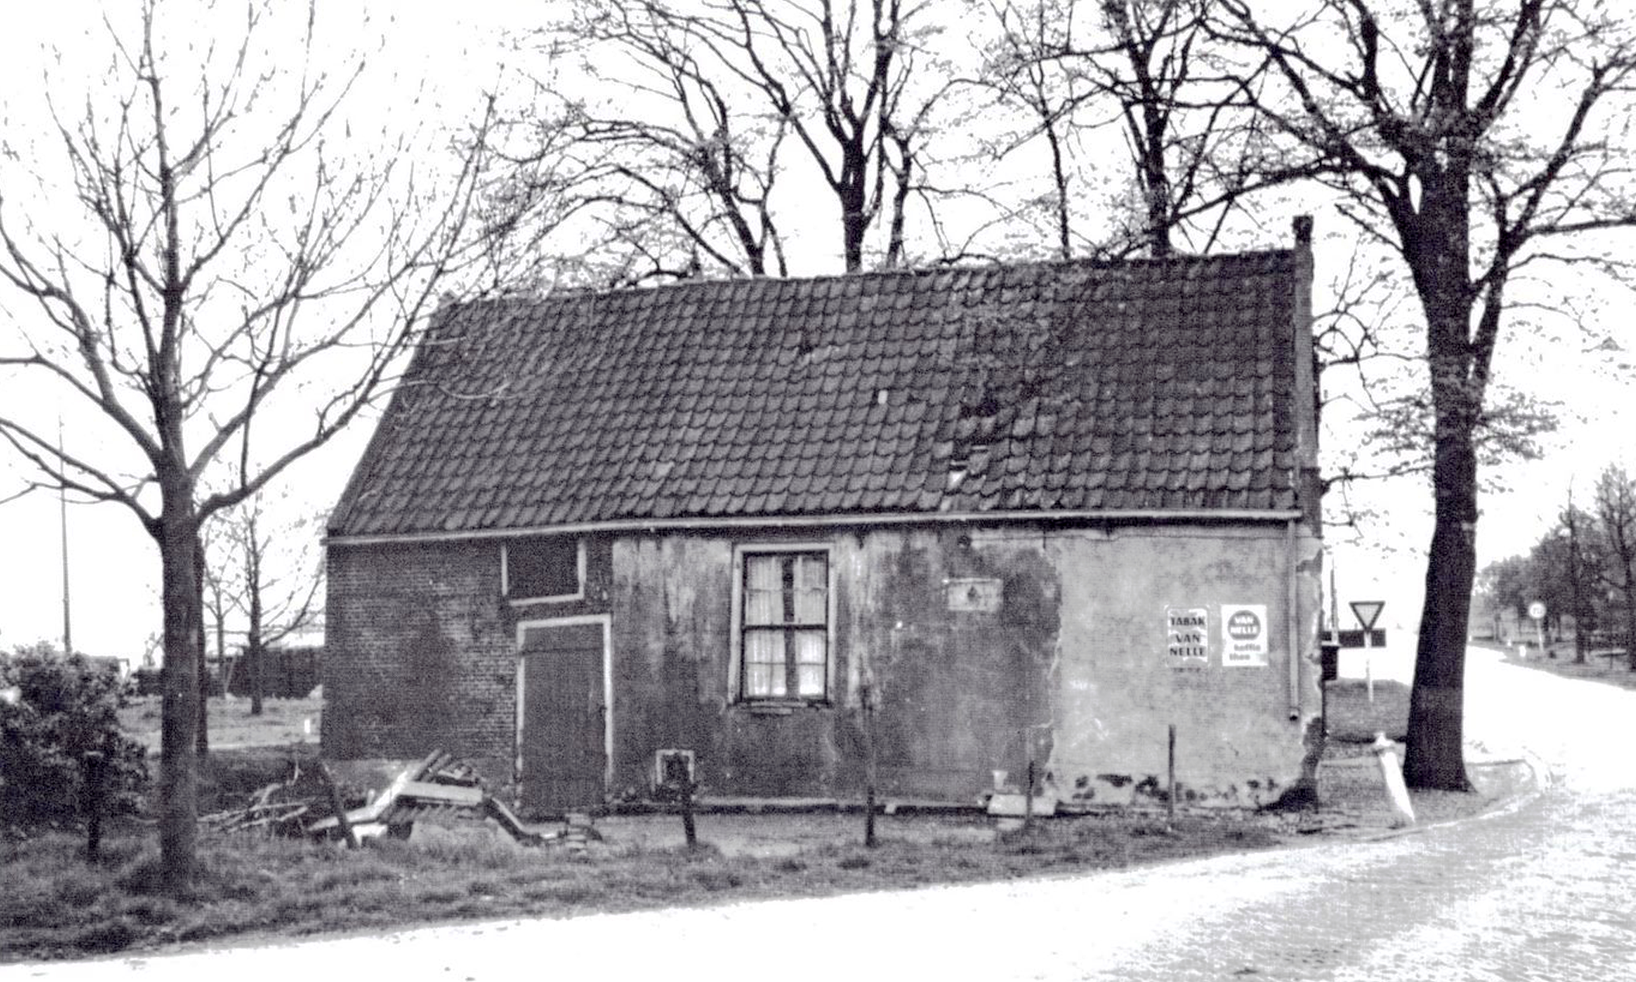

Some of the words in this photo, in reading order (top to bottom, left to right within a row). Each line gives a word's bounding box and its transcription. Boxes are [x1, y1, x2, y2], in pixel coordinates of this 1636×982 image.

[1170, 616, 1205, 626] TABAK
[1234, 616, 1253, 624] VAN
[1230, 626, 1257, 634] NELLE
[1175, 634, 1201, 643] VAN
[1169, 647, 1205, 656] NELLE
